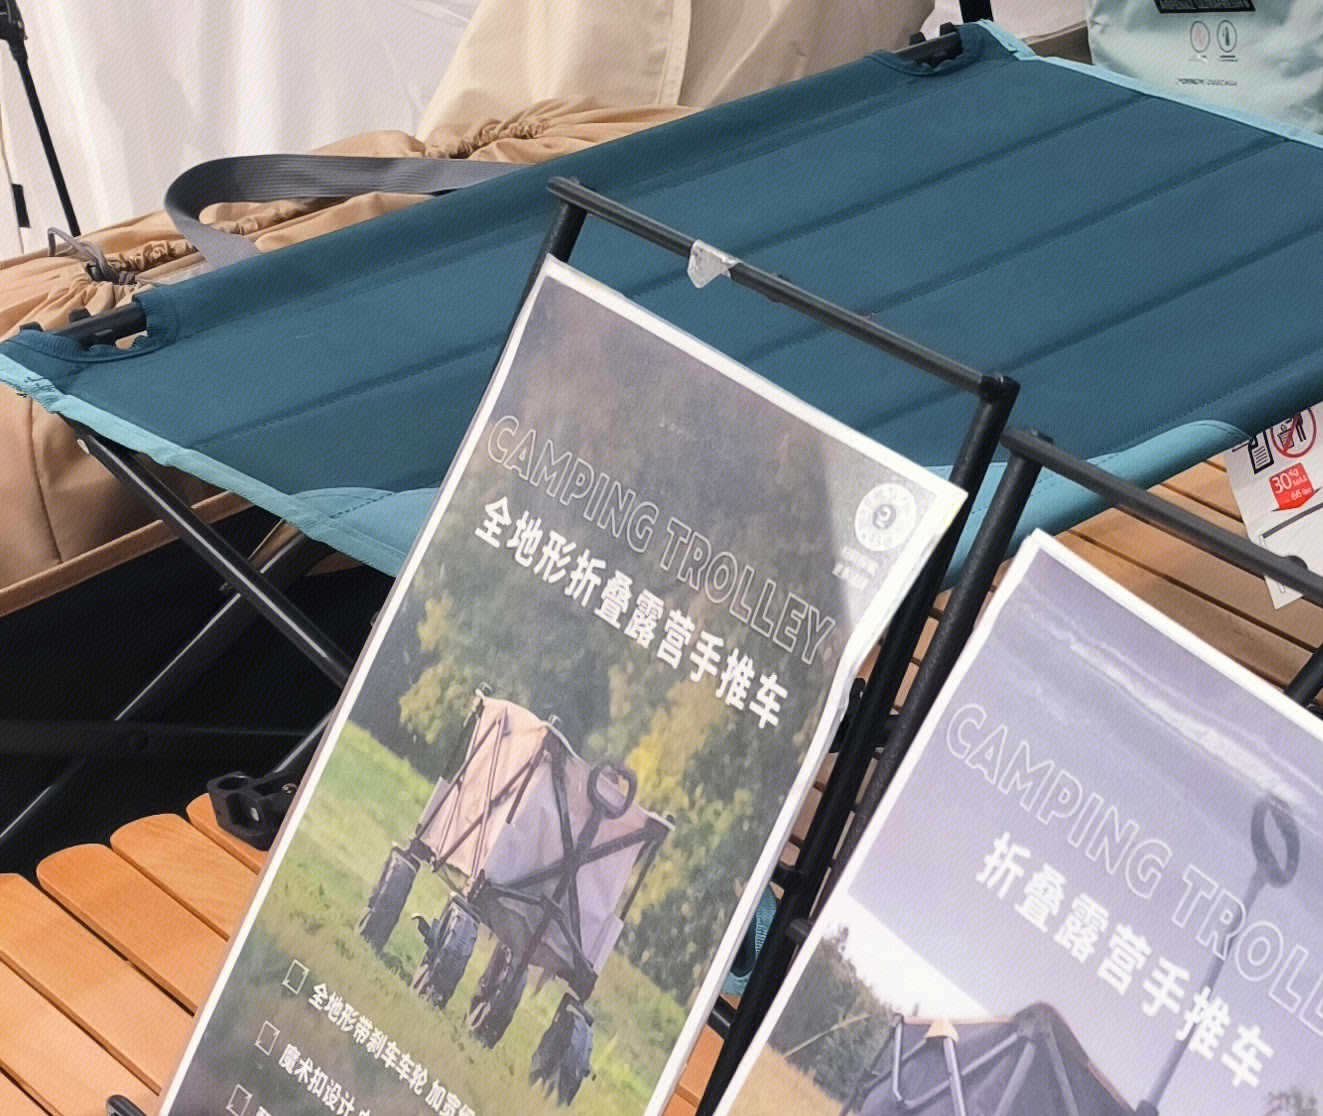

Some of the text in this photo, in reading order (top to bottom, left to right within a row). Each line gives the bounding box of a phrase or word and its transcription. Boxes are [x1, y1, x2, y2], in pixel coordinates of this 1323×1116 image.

[487, 415, 835, 664] CAMPING TROLLEY
[1271, 472, 1293, 494] 30
[474, 496, 788, 729] 全地形折叠露营手推车
[945, 703, 1173, 899] CAMPING
[308, 981, 428, 1096] 全地形带刹车车轮
[975, 831, 1274, 1088] 折叠露营手推车
